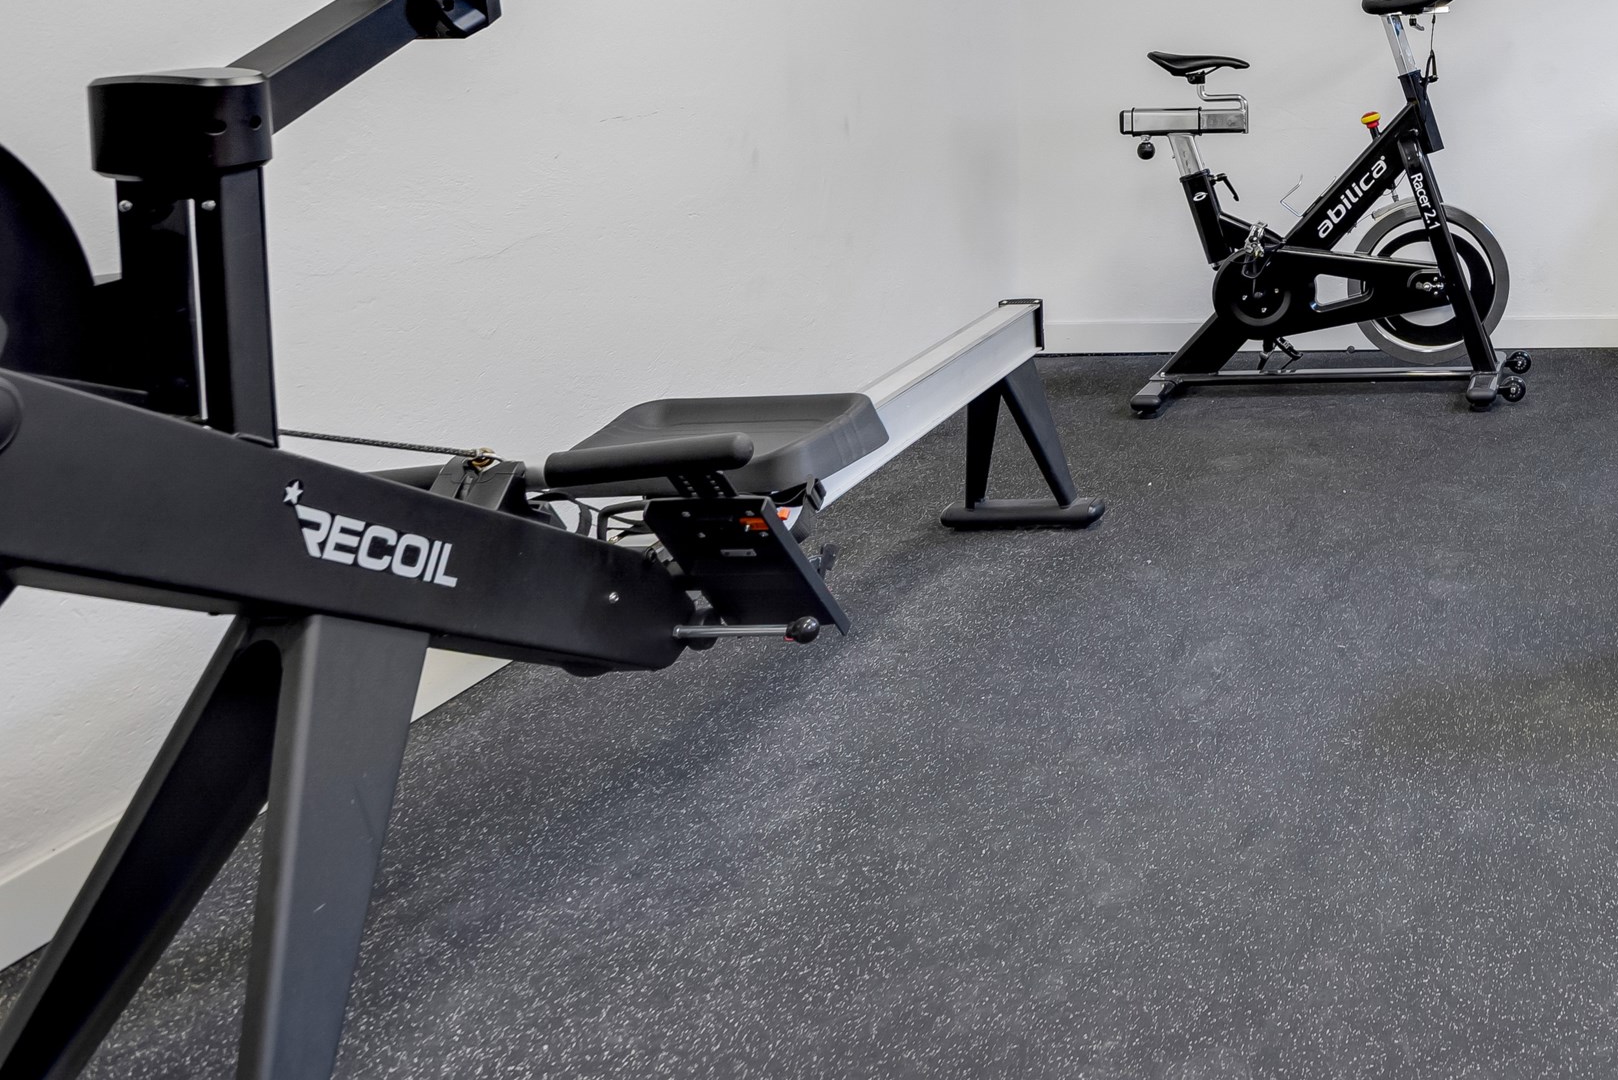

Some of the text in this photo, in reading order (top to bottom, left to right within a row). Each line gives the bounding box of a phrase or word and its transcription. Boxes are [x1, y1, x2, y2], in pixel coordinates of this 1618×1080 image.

[1317, 159, 1388, 239] abilica
[1410, 172, 1441, 230] Racer 2.1
[294, 504, 459, 588] RECOIL
